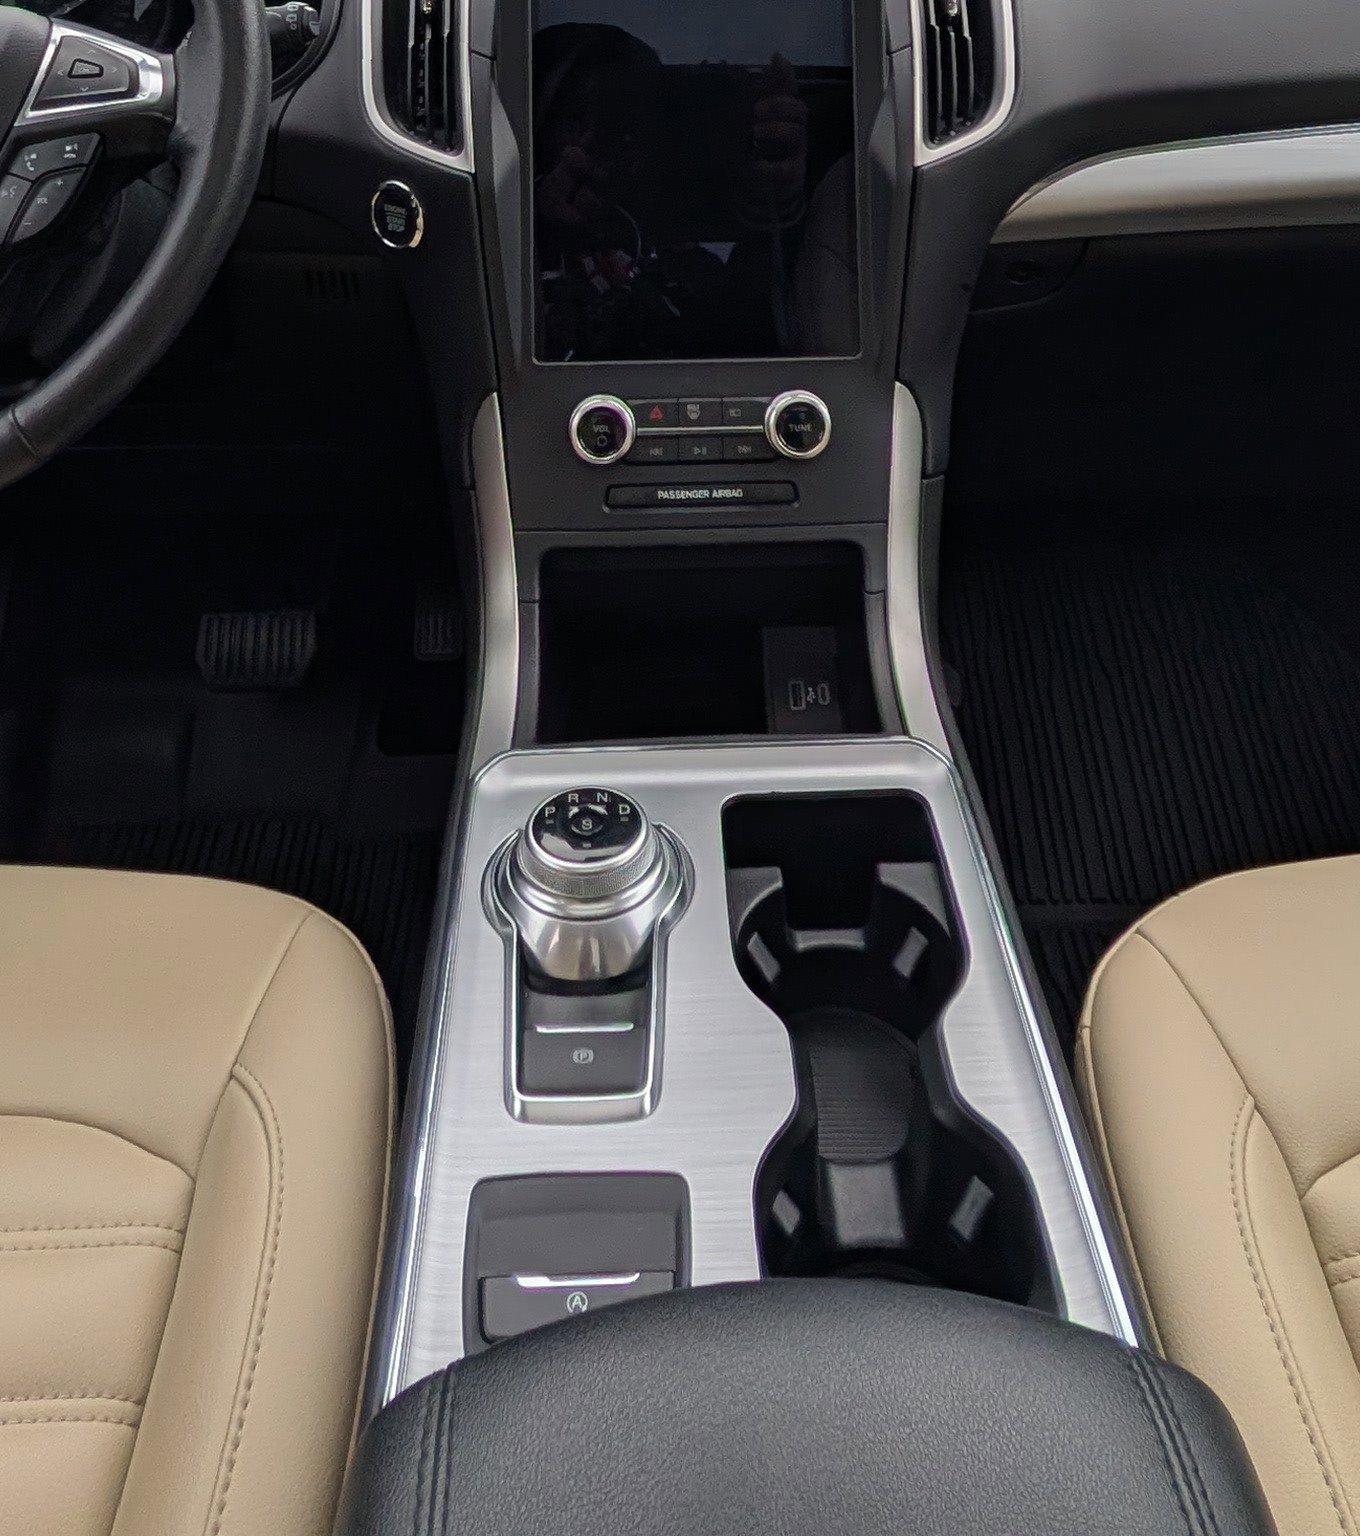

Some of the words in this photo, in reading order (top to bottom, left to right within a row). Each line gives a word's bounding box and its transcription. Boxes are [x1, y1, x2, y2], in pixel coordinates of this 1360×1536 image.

[789, 422, 814, 433] TUNE
[657, 489, 710, 500] PASSENGER
[712, 488, 744, 499] AIRBAG
[568, 793, 579, 803] R
[596, 792, 609, 803] N
[544, 806, 556, 818] P
[619, 804, 631, 815] D
